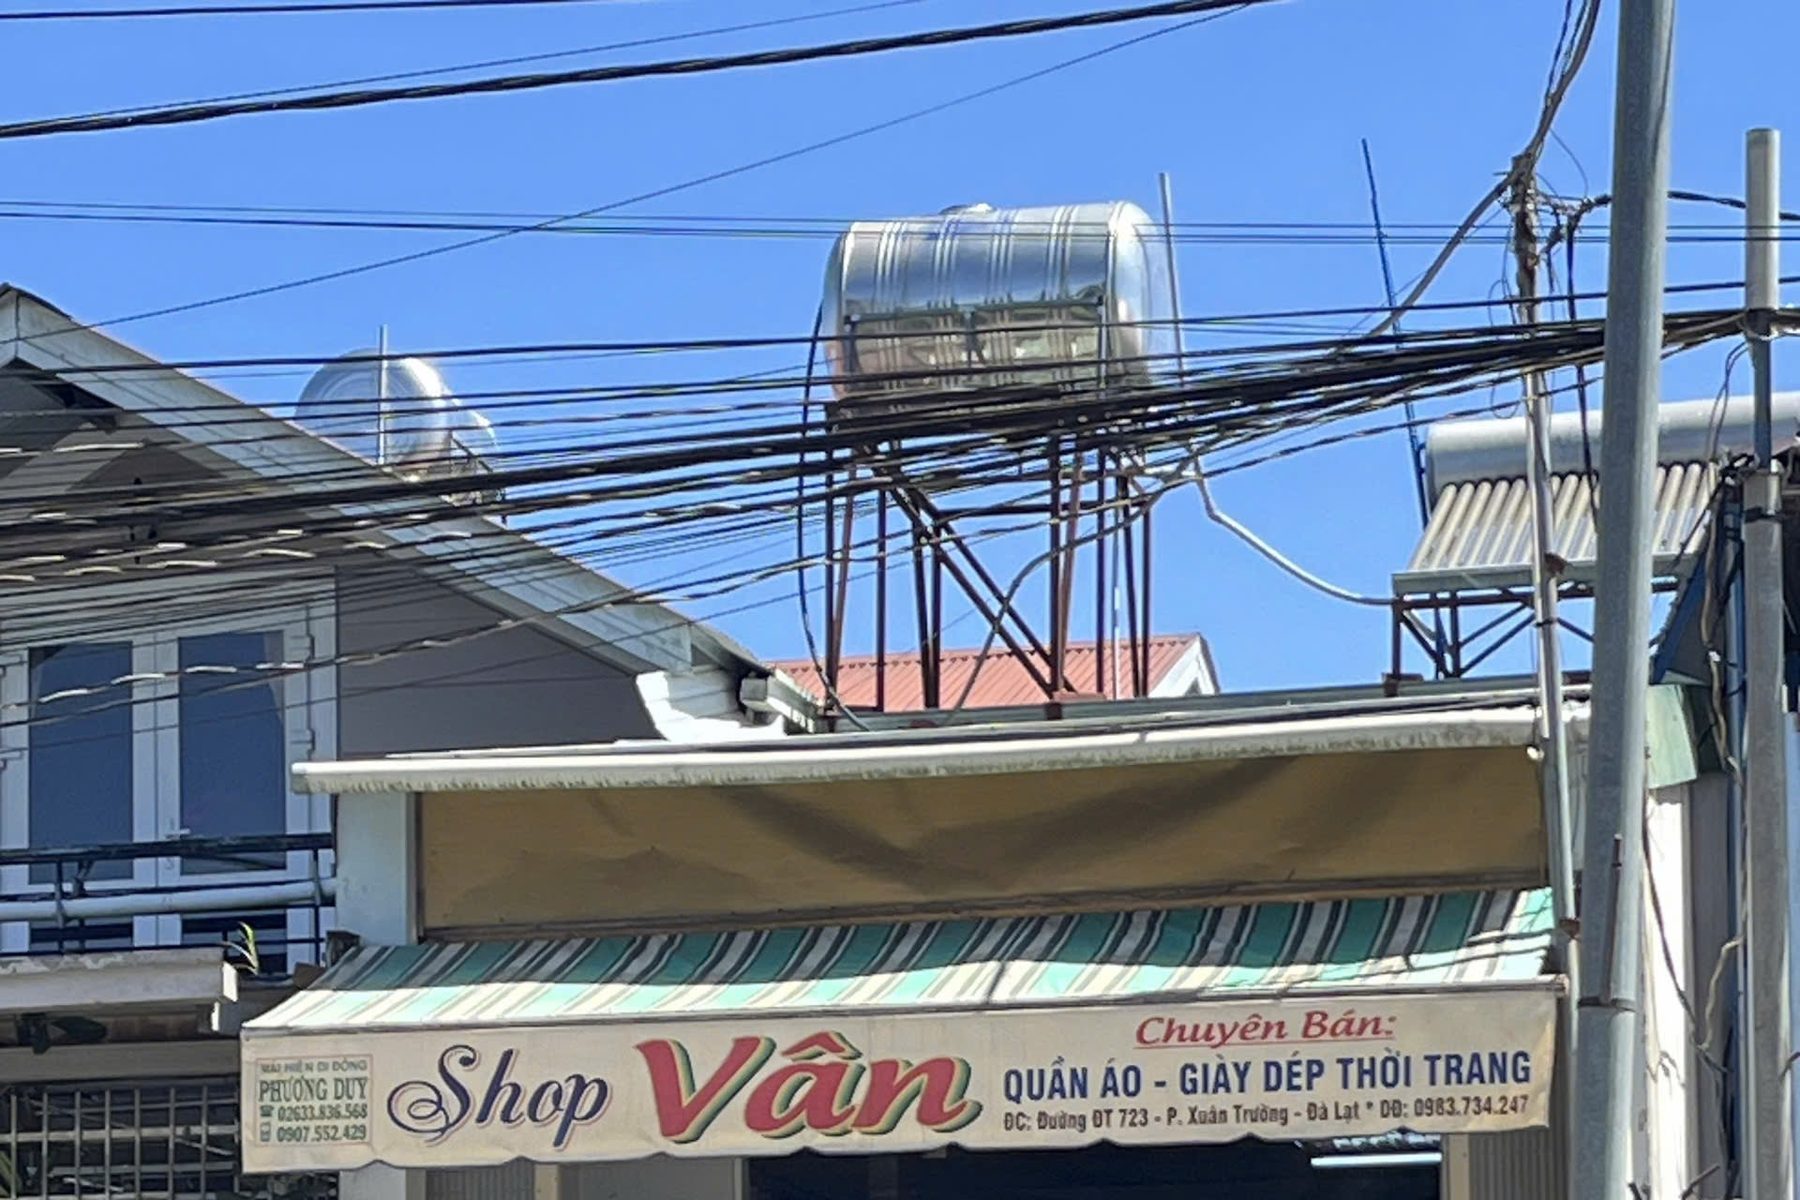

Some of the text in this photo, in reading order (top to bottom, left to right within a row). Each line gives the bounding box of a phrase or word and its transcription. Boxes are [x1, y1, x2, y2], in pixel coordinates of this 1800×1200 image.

[1135, 1008, 1397, 1049] Chuyên Bán:
[333, 1076, 368, 1101] DUY
[386, 1030, 983, 1149] Shop Vân
[1003, 1055, 1088, 1105] QUẦN
[1100, 1057, 1142, 1099] ÁO
[1179, 1053, 1252, 1096] GIÀY
[1263, 1050, 1325, 1092] DÉP
[1336, 1046, 1411, 1090] THỜI
[1423, 1049, 1531, 1087] TRANG
[1119, 1106, 1149, 1128] 723
[1187, 1104, 1228, 1125] Xuân
[1233, 1103, 1288, 1127] Trường
[1306, 1101, 1329, 1121] Đà
[1334, 1100, 1360, 1124] Lạt
